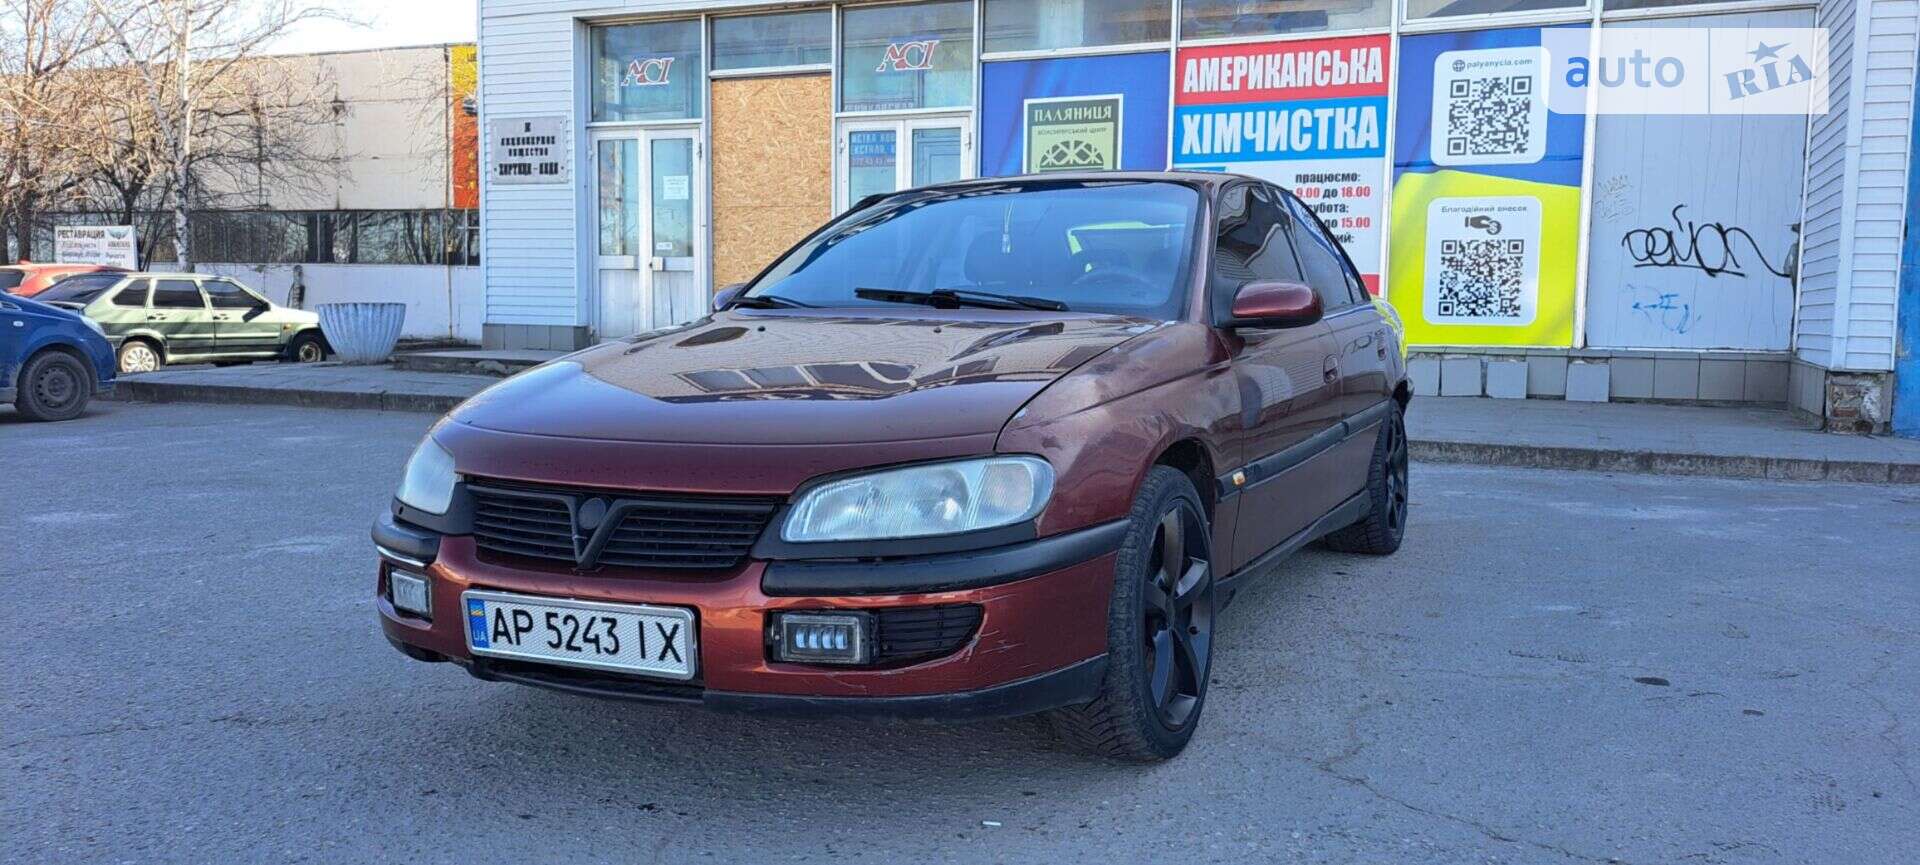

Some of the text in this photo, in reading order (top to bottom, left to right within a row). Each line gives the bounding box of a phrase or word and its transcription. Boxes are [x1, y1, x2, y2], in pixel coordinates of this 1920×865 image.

[1183, 47, 1383, 93] АМЕРИКАНСЬКА
[1034, 105, 1112, 122] ПАЛЯНИЦЯ
[1181, 106, 1379, 155] ХІМЧИСТКА
[1295, 172, 1361, 184] працюємо:
[1322, 188, 1338, 199] до
[1341, 186, 1371, 198] 18.00
[1341, 217, 1371, 229] 15.00
[473, 630, 488, 643] UA
[492, 607, 535, 646] AP
[545, 611, 621, 656] 5243
